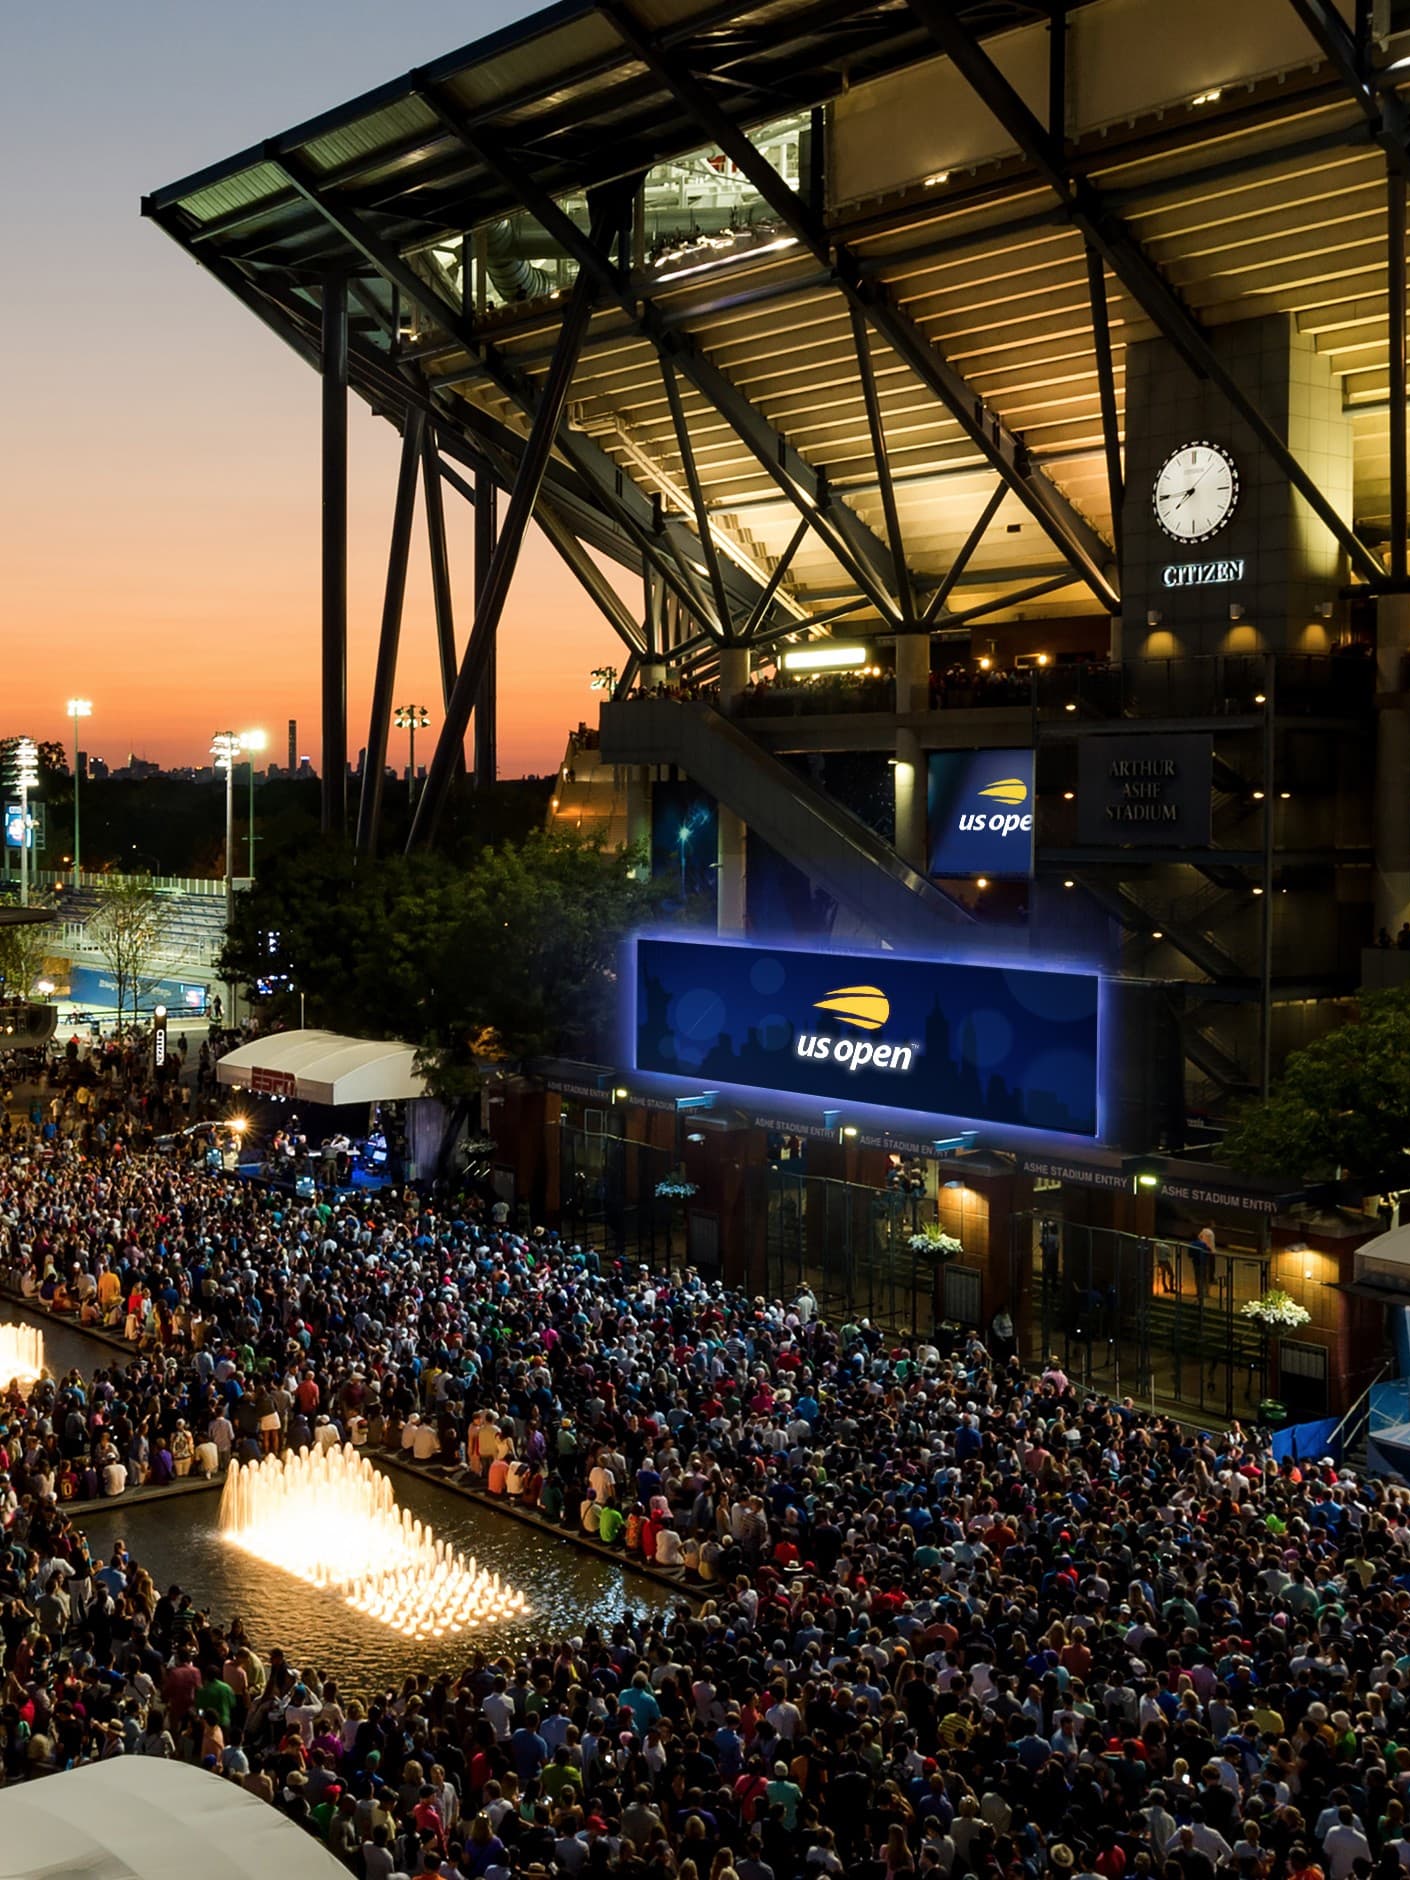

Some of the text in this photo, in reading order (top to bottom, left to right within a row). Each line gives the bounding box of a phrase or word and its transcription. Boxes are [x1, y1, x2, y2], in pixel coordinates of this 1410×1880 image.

[1163, 560, 1244, 587] CITIZEN
[1110, 759, 1175, 777] ARTHUR
[1122, 782, 1161, 798] ASHE
[1106, 804, 1177, 821] STADIUM
[958, 814, 1033, 837] us ope
[156, 1029, 165, 1066] CITIZEN
[797, 1035, 832, 1059] us
[834, 1040, 912, 1071] open
[252, 1066, 297, 1098] ESPN
[563, 1084, 588, 1096] STADIUM
[755, 1117, 836, 1139] ASHE STADIUM ENTRY
[860, 1135, 881, 1148] ASHE
[883, 1139, 920, 1154] STADIUM
[1023, 1161, 1128, 1188] ASHE STADIUM ENTRY
[1161, 1184, 1189, 1199] ASHE
[1191, 1189, 1239, 1207] STADIUM
